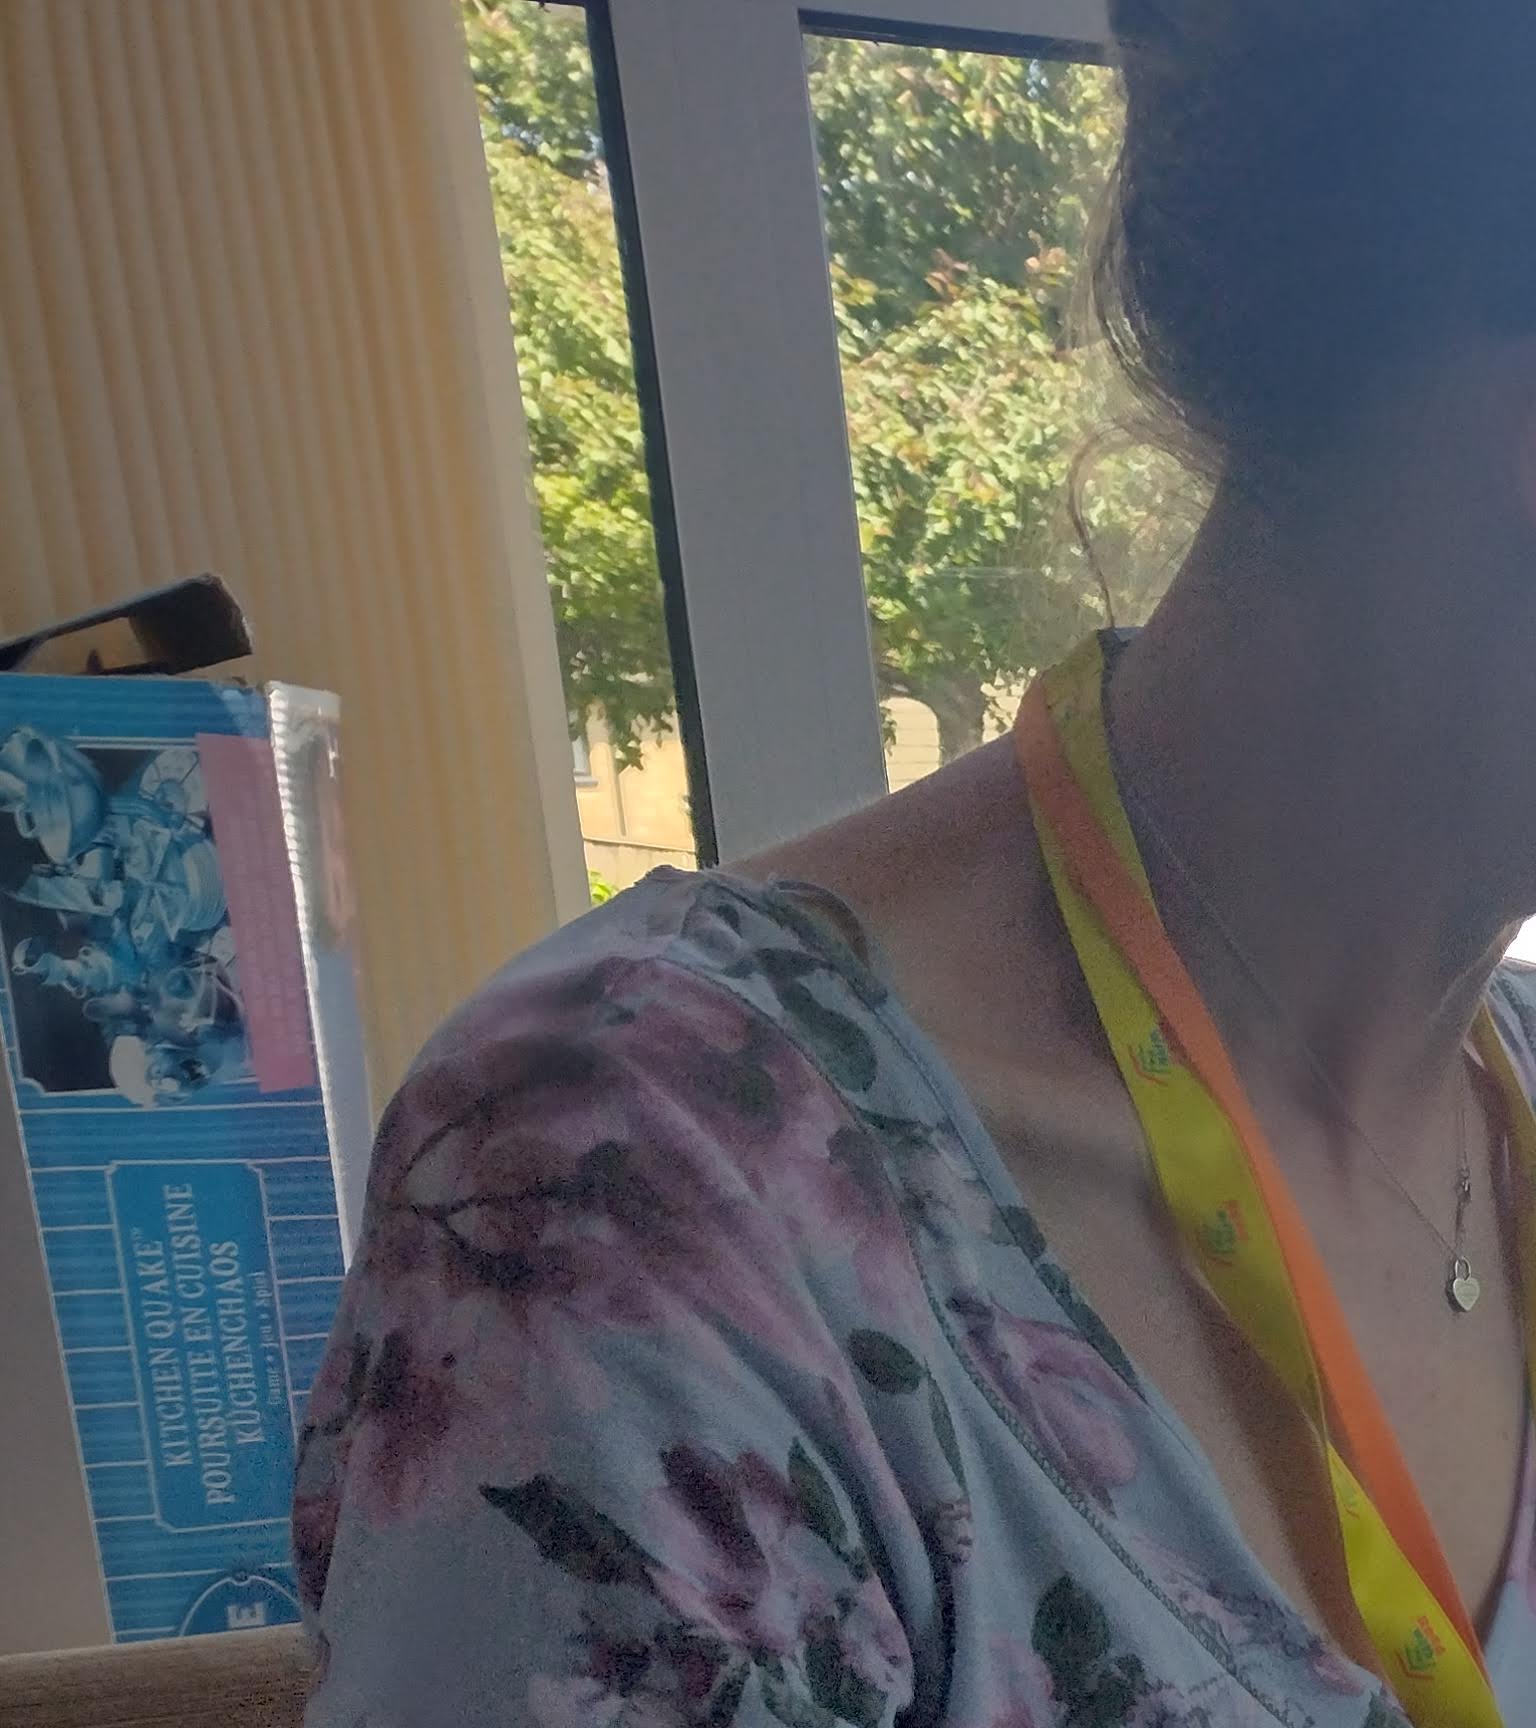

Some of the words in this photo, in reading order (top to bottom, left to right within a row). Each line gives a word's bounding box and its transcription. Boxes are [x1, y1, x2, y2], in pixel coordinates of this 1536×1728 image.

[164, 1182, 206, 1300] CUISINE
[182, 1306, 212, 1342] EN
[149, 1347, 194, 1467] KITCHEN
[187, 1350, 236, 1505] POURSUITE
